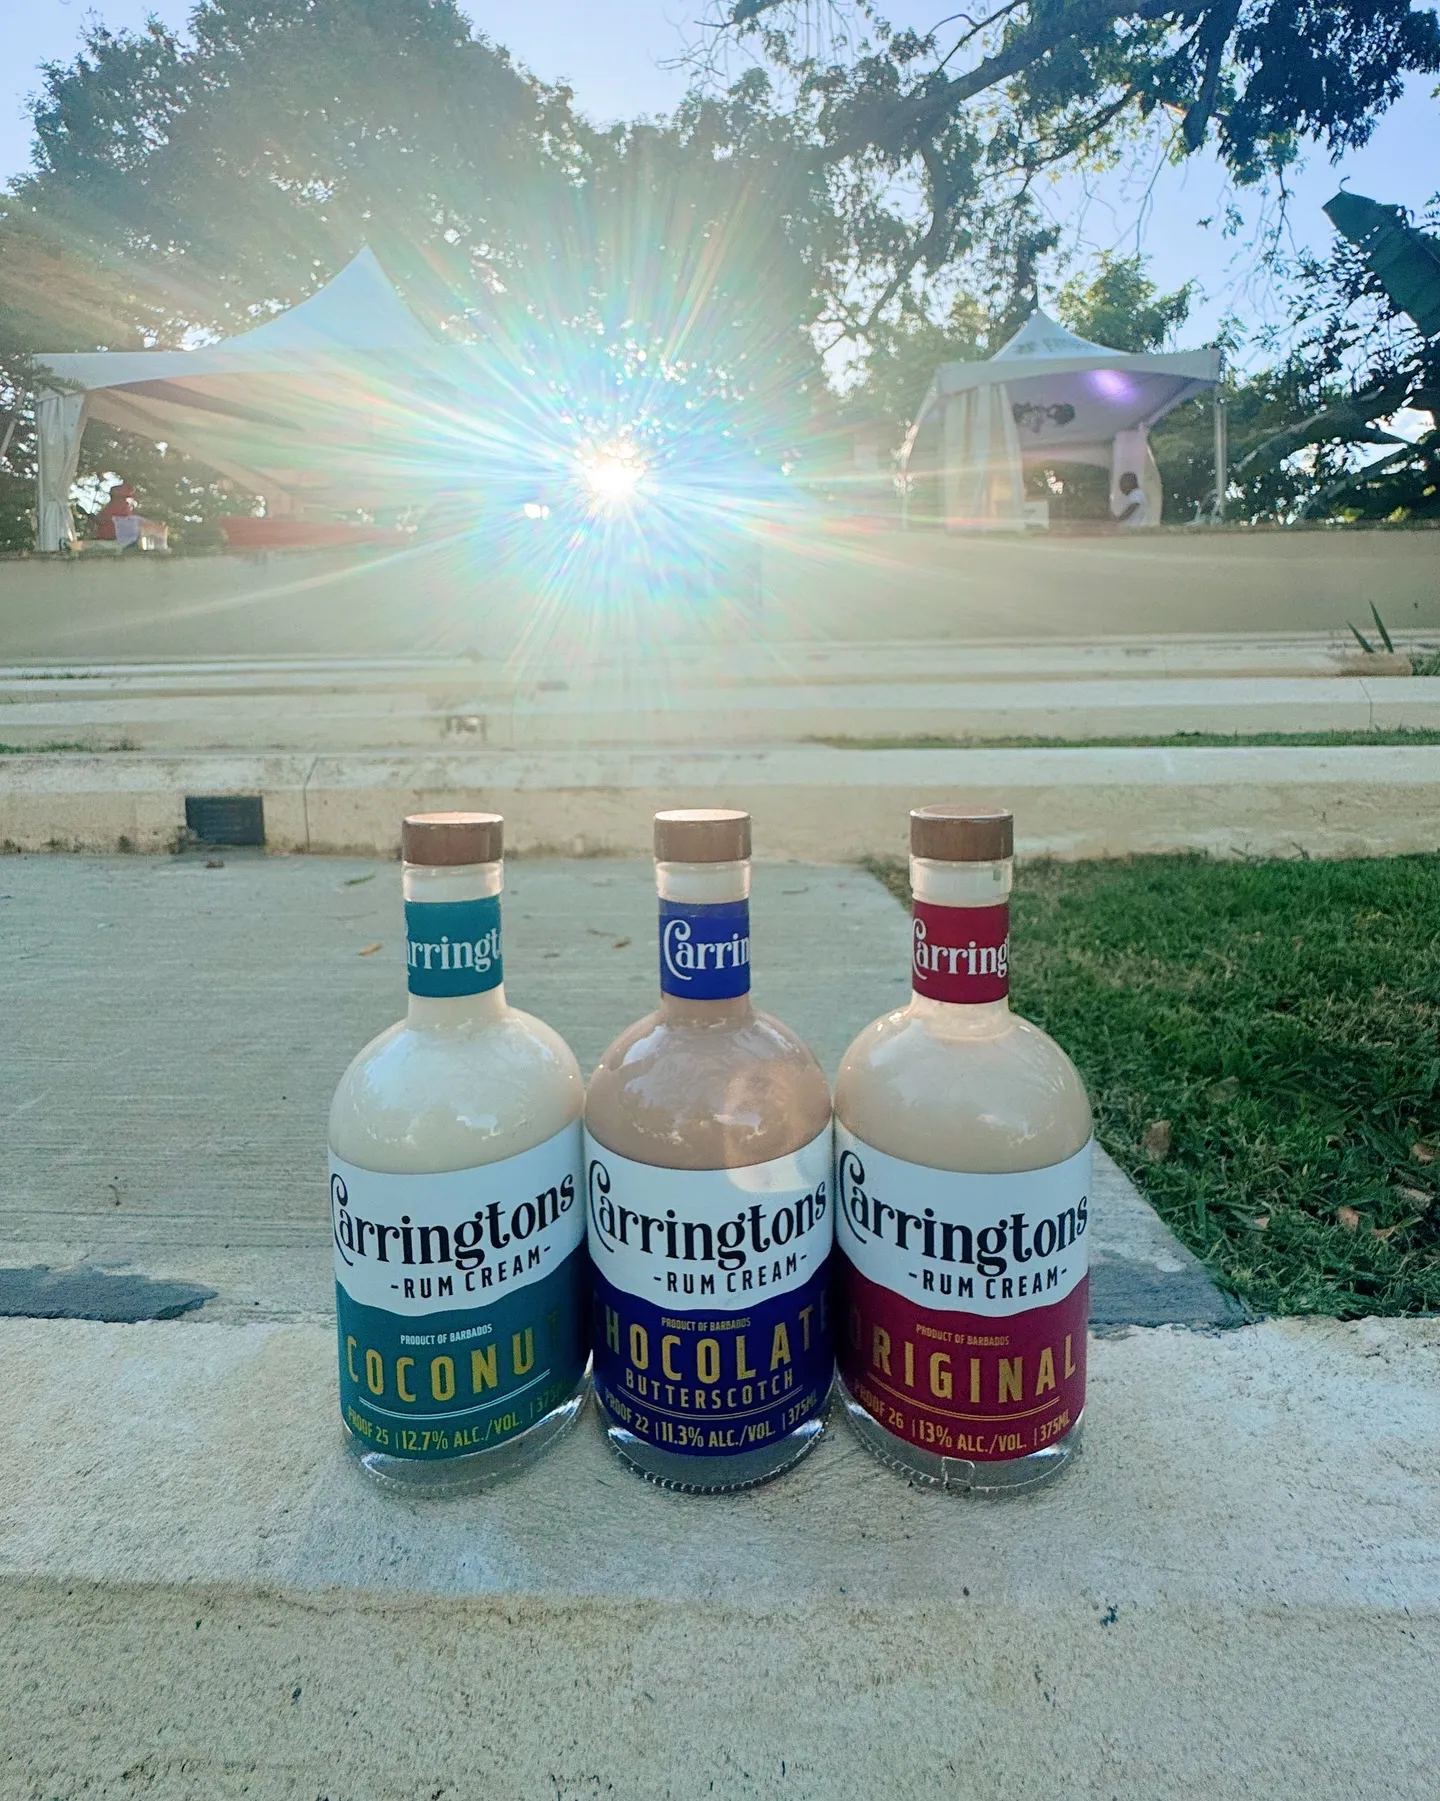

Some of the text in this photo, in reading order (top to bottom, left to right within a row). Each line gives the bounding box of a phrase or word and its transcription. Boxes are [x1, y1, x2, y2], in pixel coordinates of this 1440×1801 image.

[407, 928, 501, 973] rringt
[913, 918, 1009, 980] Carring
[331, 1173, 575, 1270] Carringtons
[589, 1159, 826, 1271] Carringtons
[840, 1150, 1088, 1277] Carringtons
[400, 1323, 493, 1345] PRODUCT OF BARBADOS
[594, 1288, 827, 1384] HOCOLAT
[661, 1317, 751, 1331] PRODUCT OF BARBADOS
[916, 1324, 1010, 1347] PRODUCT OF BARBADOS
[625, 1368, 793, 1409] BUTTERSCOTCH
[375, 1425, 389, 1445] 25
[402, 1430, 448, 1451] 12.7%
[536, 1375, 567, 1413] 375
[635, 1413, 649, 1434] 22
[662, 1421, 704, 1447] 11.3%
[889, 1407, 904, 1430] 26
[919, 1418, 952, 1448] 13%
[1040, 1408, 1070, 1441] 375ML
